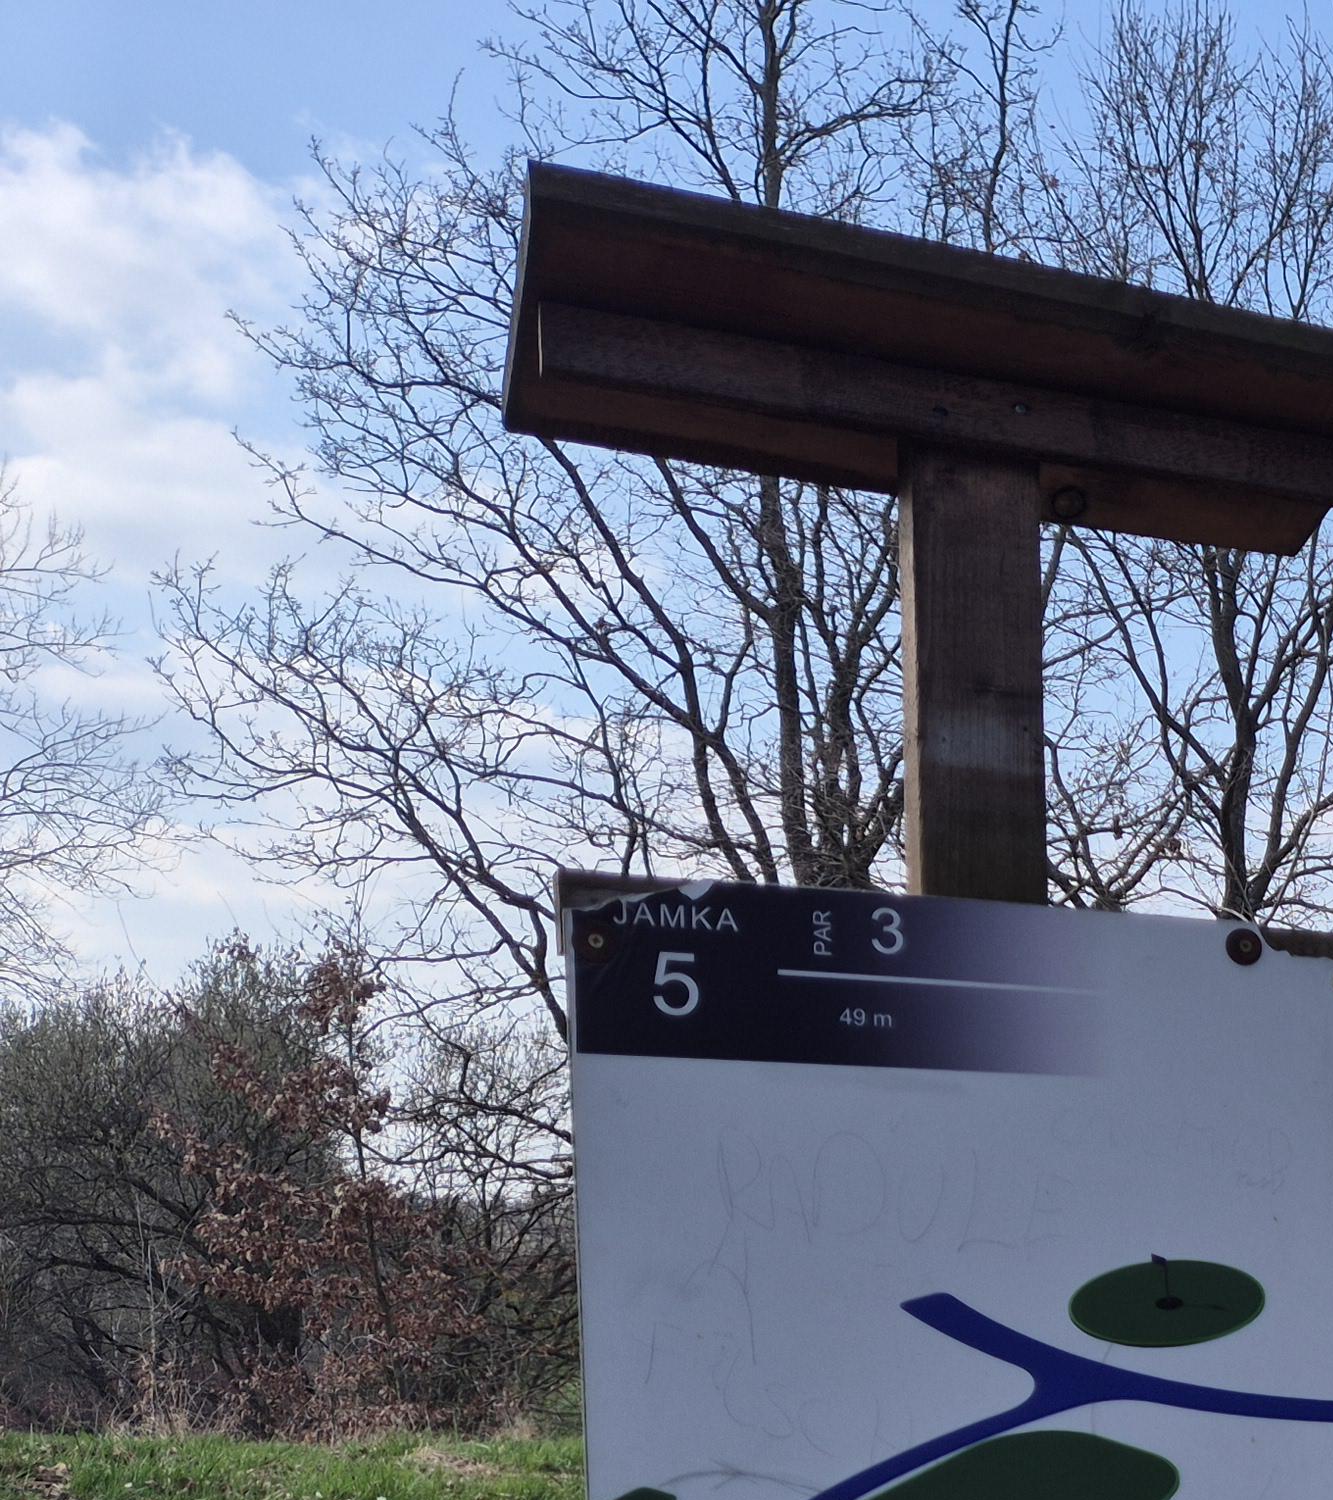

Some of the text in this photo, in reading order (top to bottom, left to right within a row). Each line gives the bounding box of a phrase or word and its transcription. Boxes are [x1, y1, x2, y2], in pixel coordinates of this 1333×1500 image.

[613, 900, 739, 933] JAMKA
[812, 909, 832, 957] PAR
[870, 906, 905, 956] 3
[652, 950, 700, 1017] 5
[838, 1007, 893, 1029] 49 m
